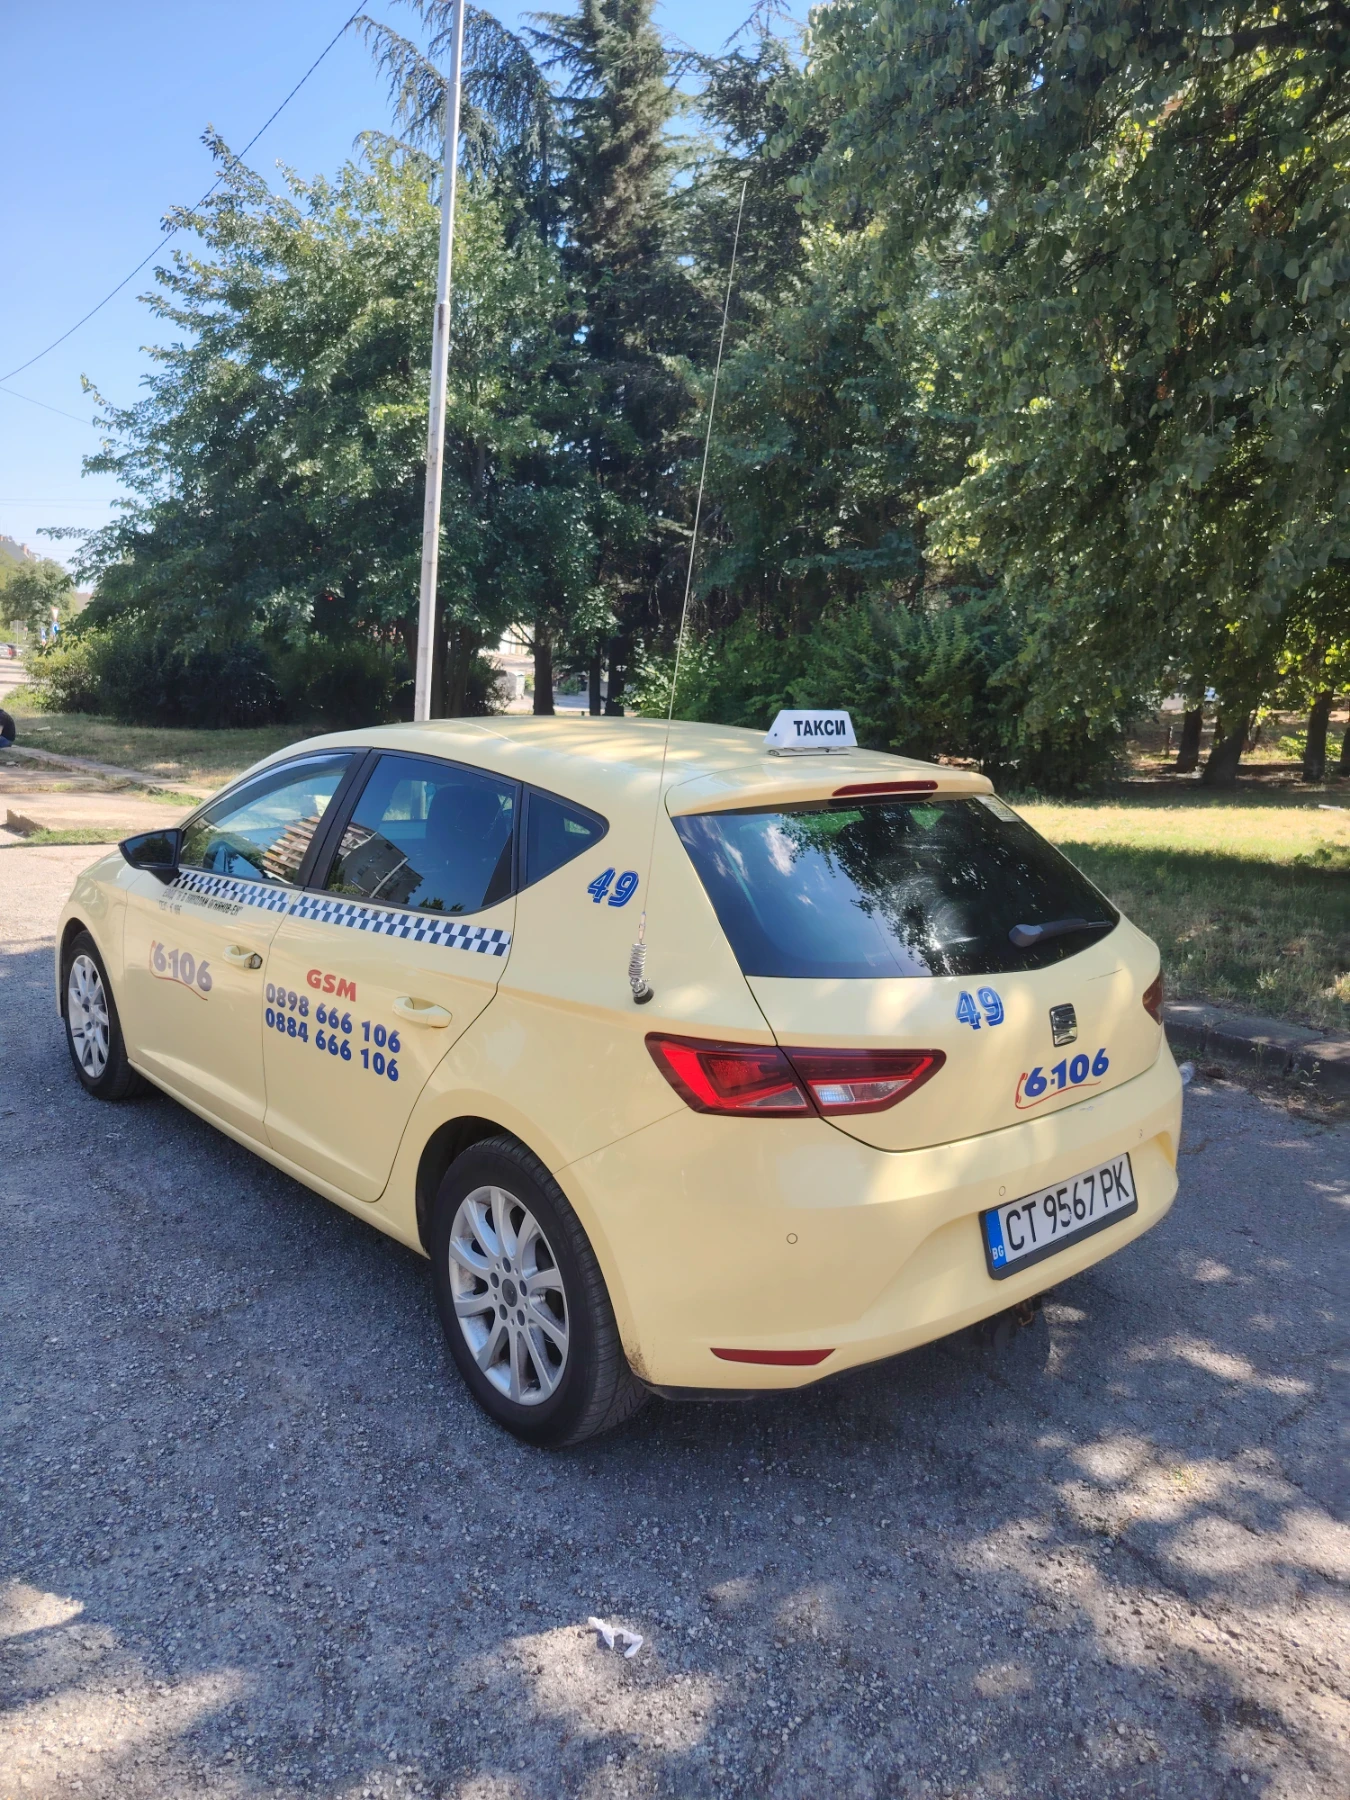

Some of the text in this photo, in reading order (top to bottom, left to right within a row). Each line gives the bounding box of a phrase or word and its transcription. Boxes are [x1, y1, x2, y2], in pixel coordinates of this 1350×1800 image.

[793, 719, 846, 737] ТАКСИ
[587, 867, 640, 908] 49
[306, 969, 357, 1002] GSM
[266, 983, 401, 1054] 0898 666 106
[955, 986, 1005, 1030] 49
[265, 1007, 399, 1082] 0884 666 106
[1005, 1161, 1130, 1251] CT 9567 PK
[992, 1245, 1004, 1260] BG
